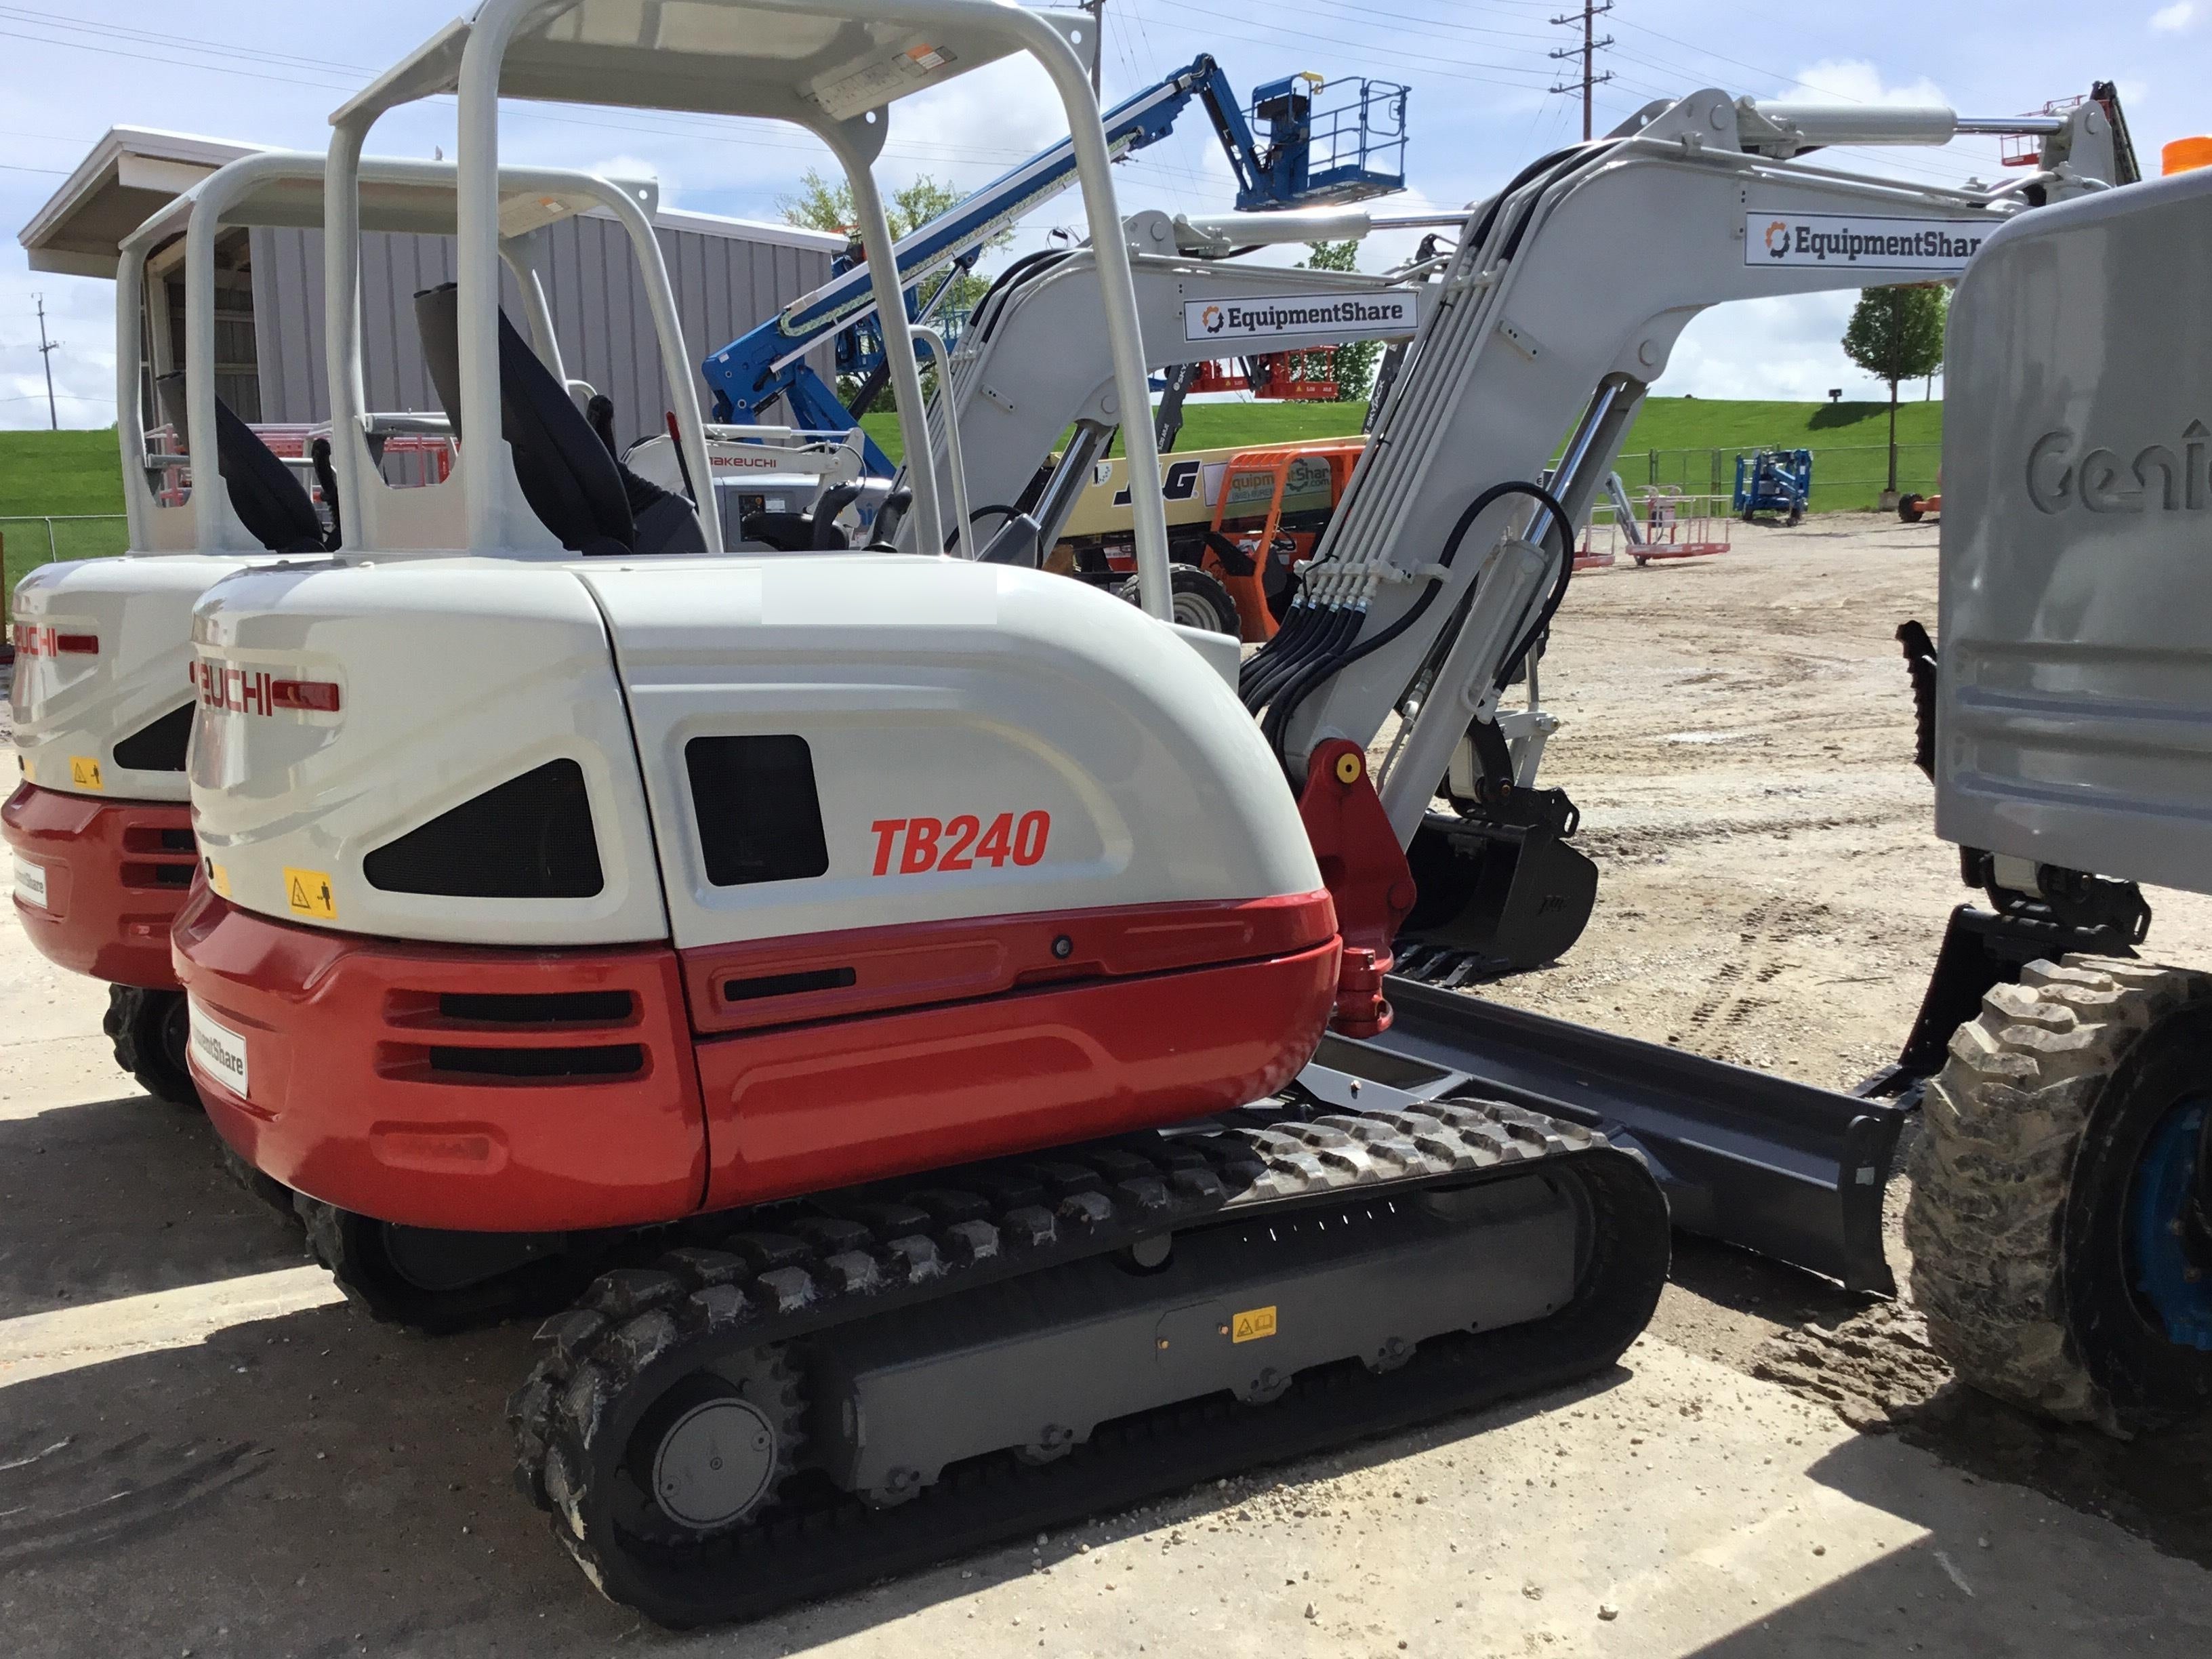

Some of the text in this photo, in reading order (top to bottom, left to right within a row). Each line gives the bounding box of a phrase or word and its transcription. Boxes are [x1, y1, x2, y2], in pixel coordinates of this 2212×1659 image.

[1795, 226, 1982, 261] EquipmentShar
[1227, 302, 1403, 331] EquipmentShare
[2026, 418, 2212, 515] Geni
[871, 810, 1050, 876] TB240
